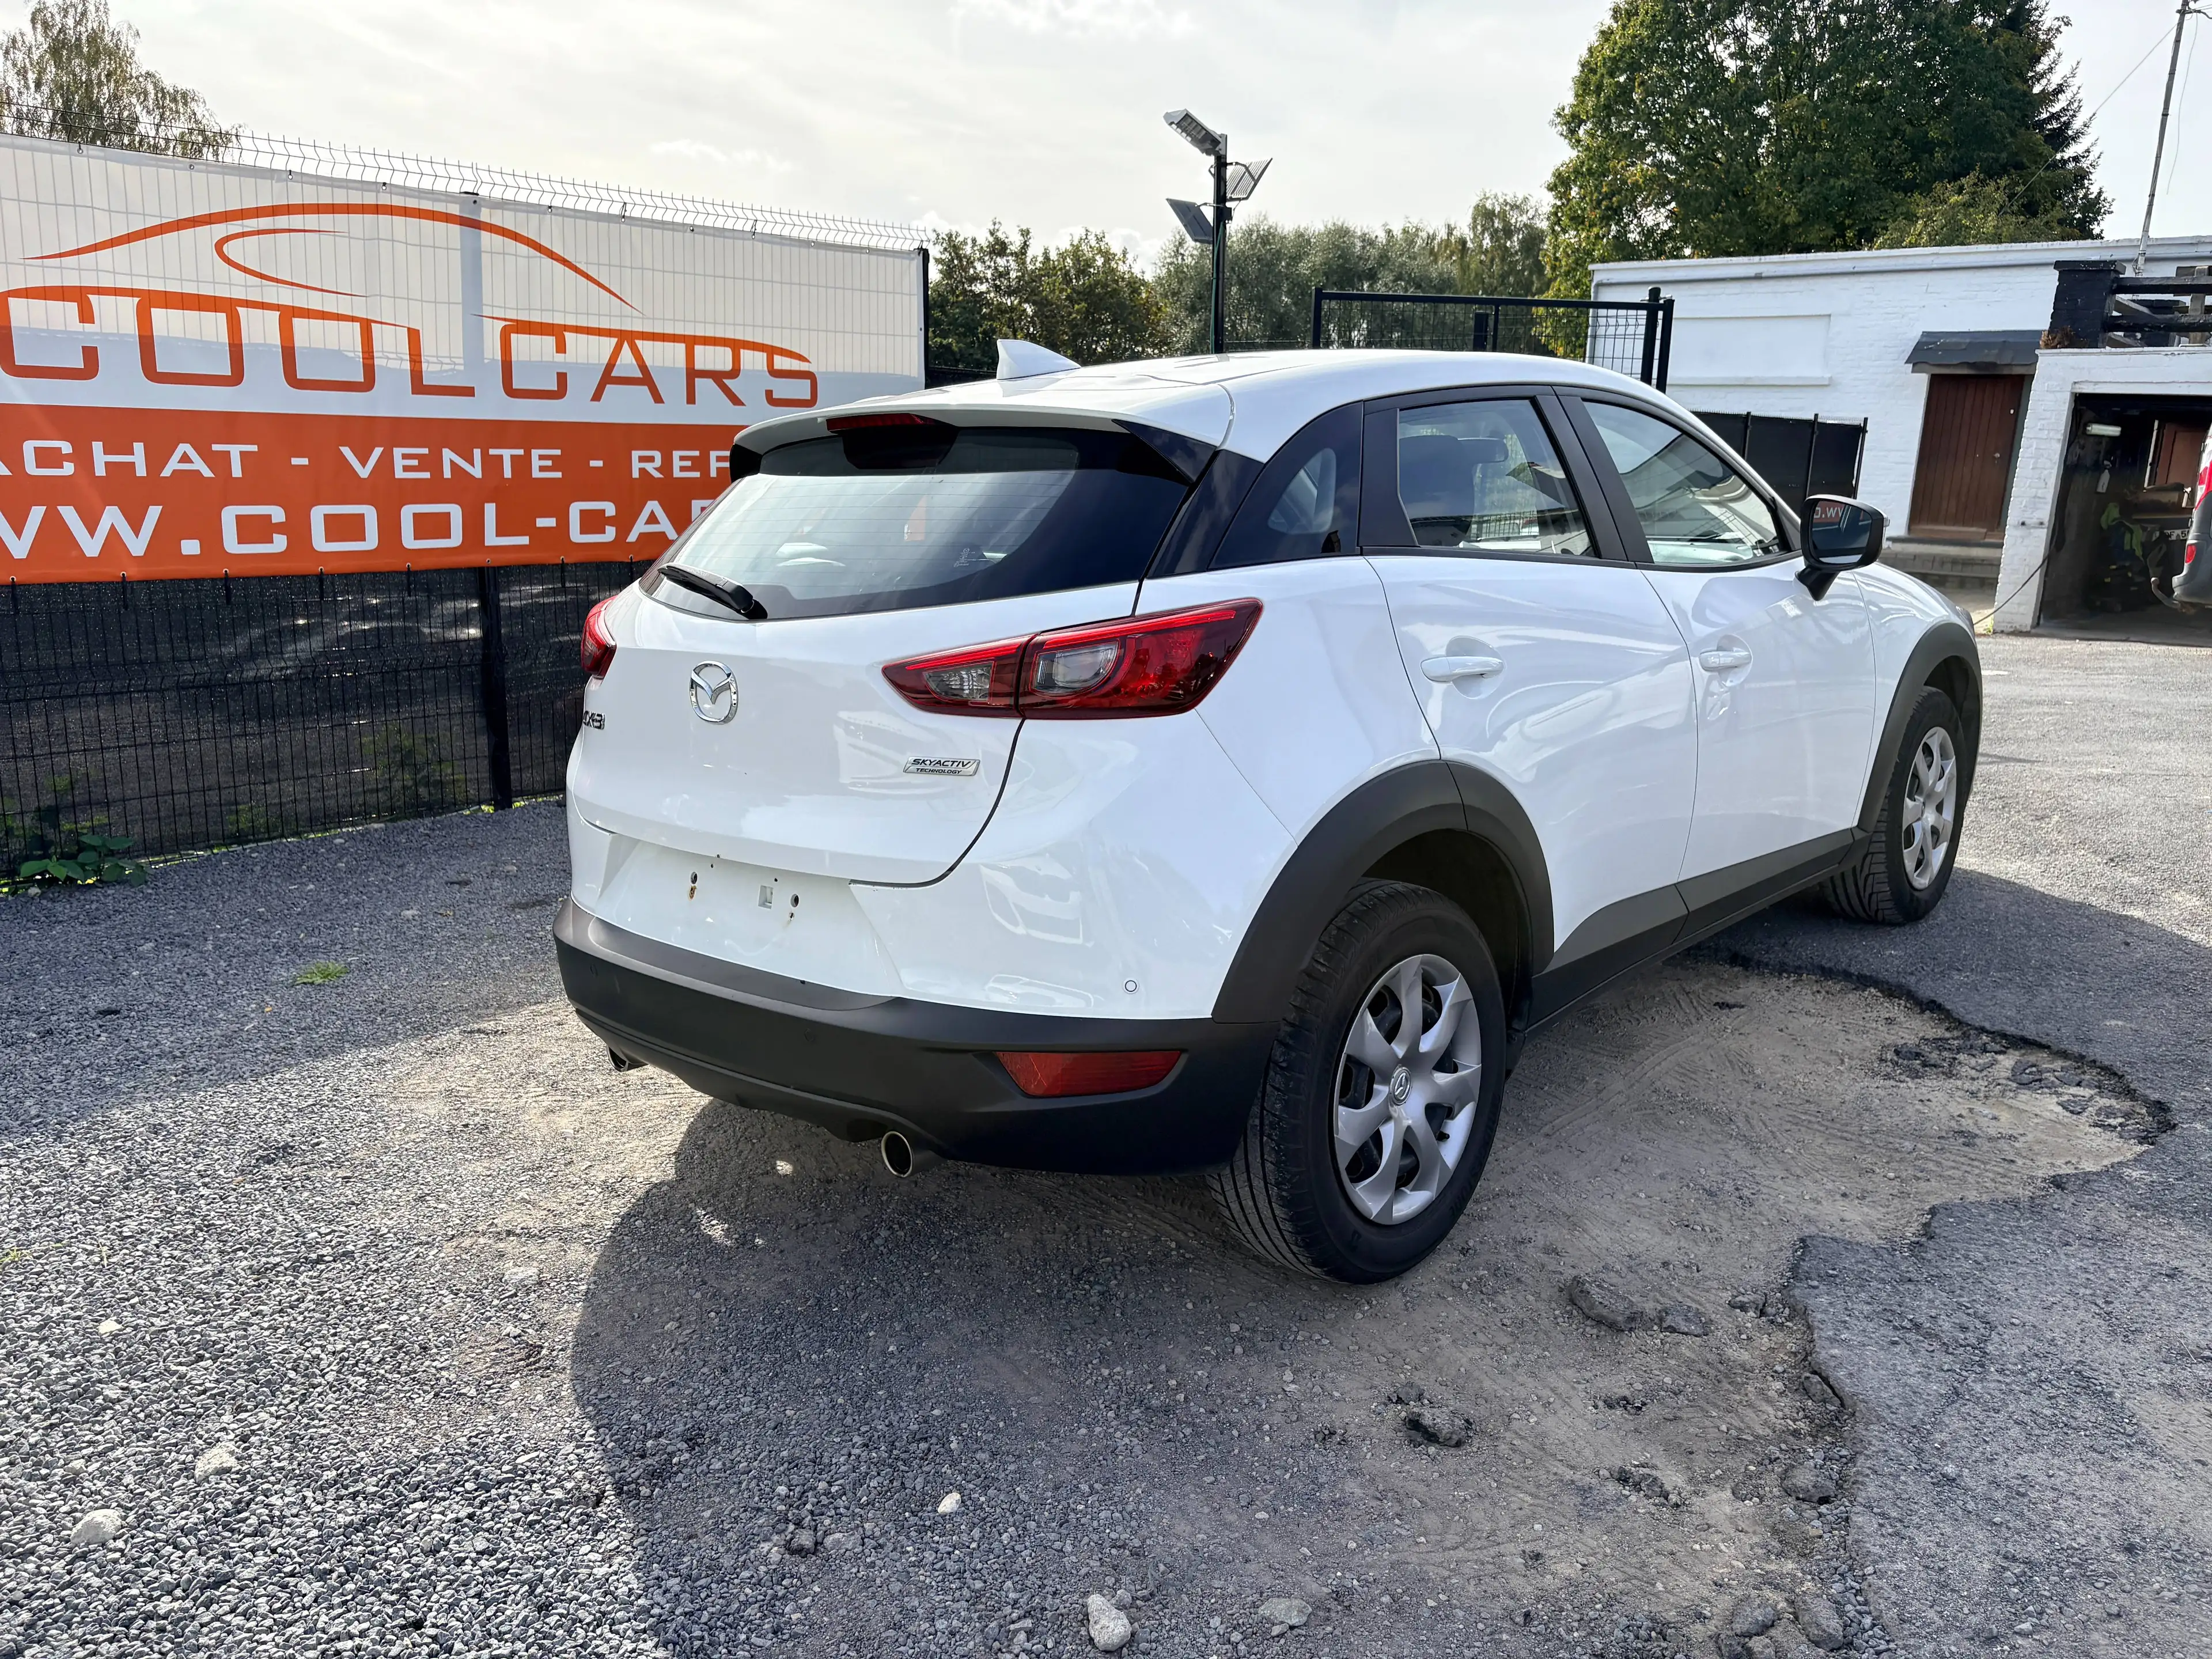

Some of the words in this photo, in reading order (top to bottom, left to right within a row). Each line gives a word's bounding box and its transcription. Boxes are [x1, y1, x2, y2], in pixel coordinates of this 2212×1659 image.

[0, 440, 258, 478] CHAT
[339, 446, 562, 478] VENTE
[911, 759, 971, 767] SKYACTIV
